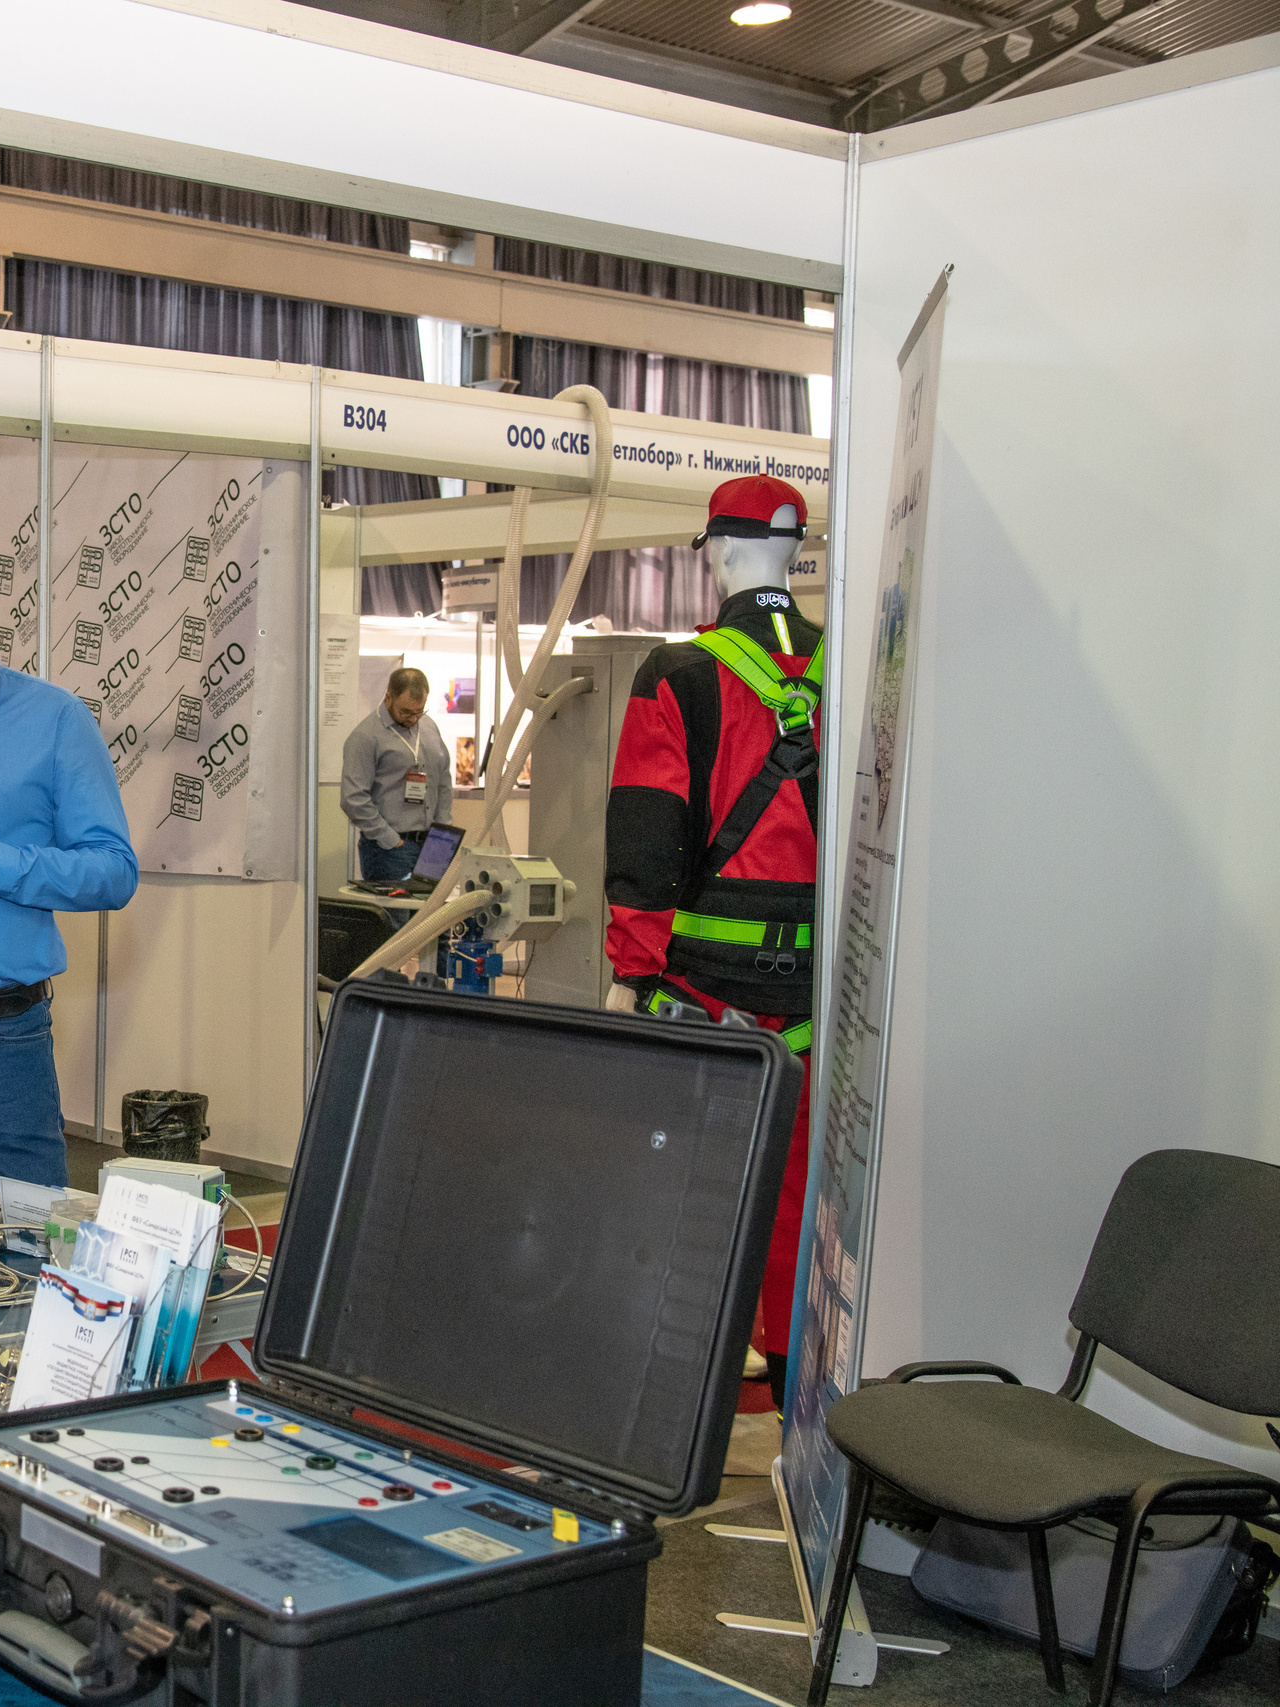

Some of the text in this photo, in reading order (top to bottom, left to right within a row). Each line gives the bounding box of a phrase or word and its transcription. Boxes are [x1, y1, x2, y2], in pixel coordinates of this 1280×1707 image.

[343, 404, 387, 432] В304
[507, 424, 546, 450] ООО
[551, 431, 590, 455] «СКБ
[613, 442, 682, 471] етлобор»
[688, 453, 698, 468] г.
[704, 450, 761, 475] Нижний
[98, 492, 142, 546] ЗСТО
[207, 479, 240, 537] ЗСТО
[98, 570, 142, 623] ЗСТО
[203, 561, 242, 618] ЗСТО
[97, 648, 140, 700] ЗСТО
[199, 642, 246, 698] ЗСТО
[108, 724, 138, 764] СТО
[197, 723, 249, 778] ЗСТО
[207, 766, 228, 787] ЗАВОД
